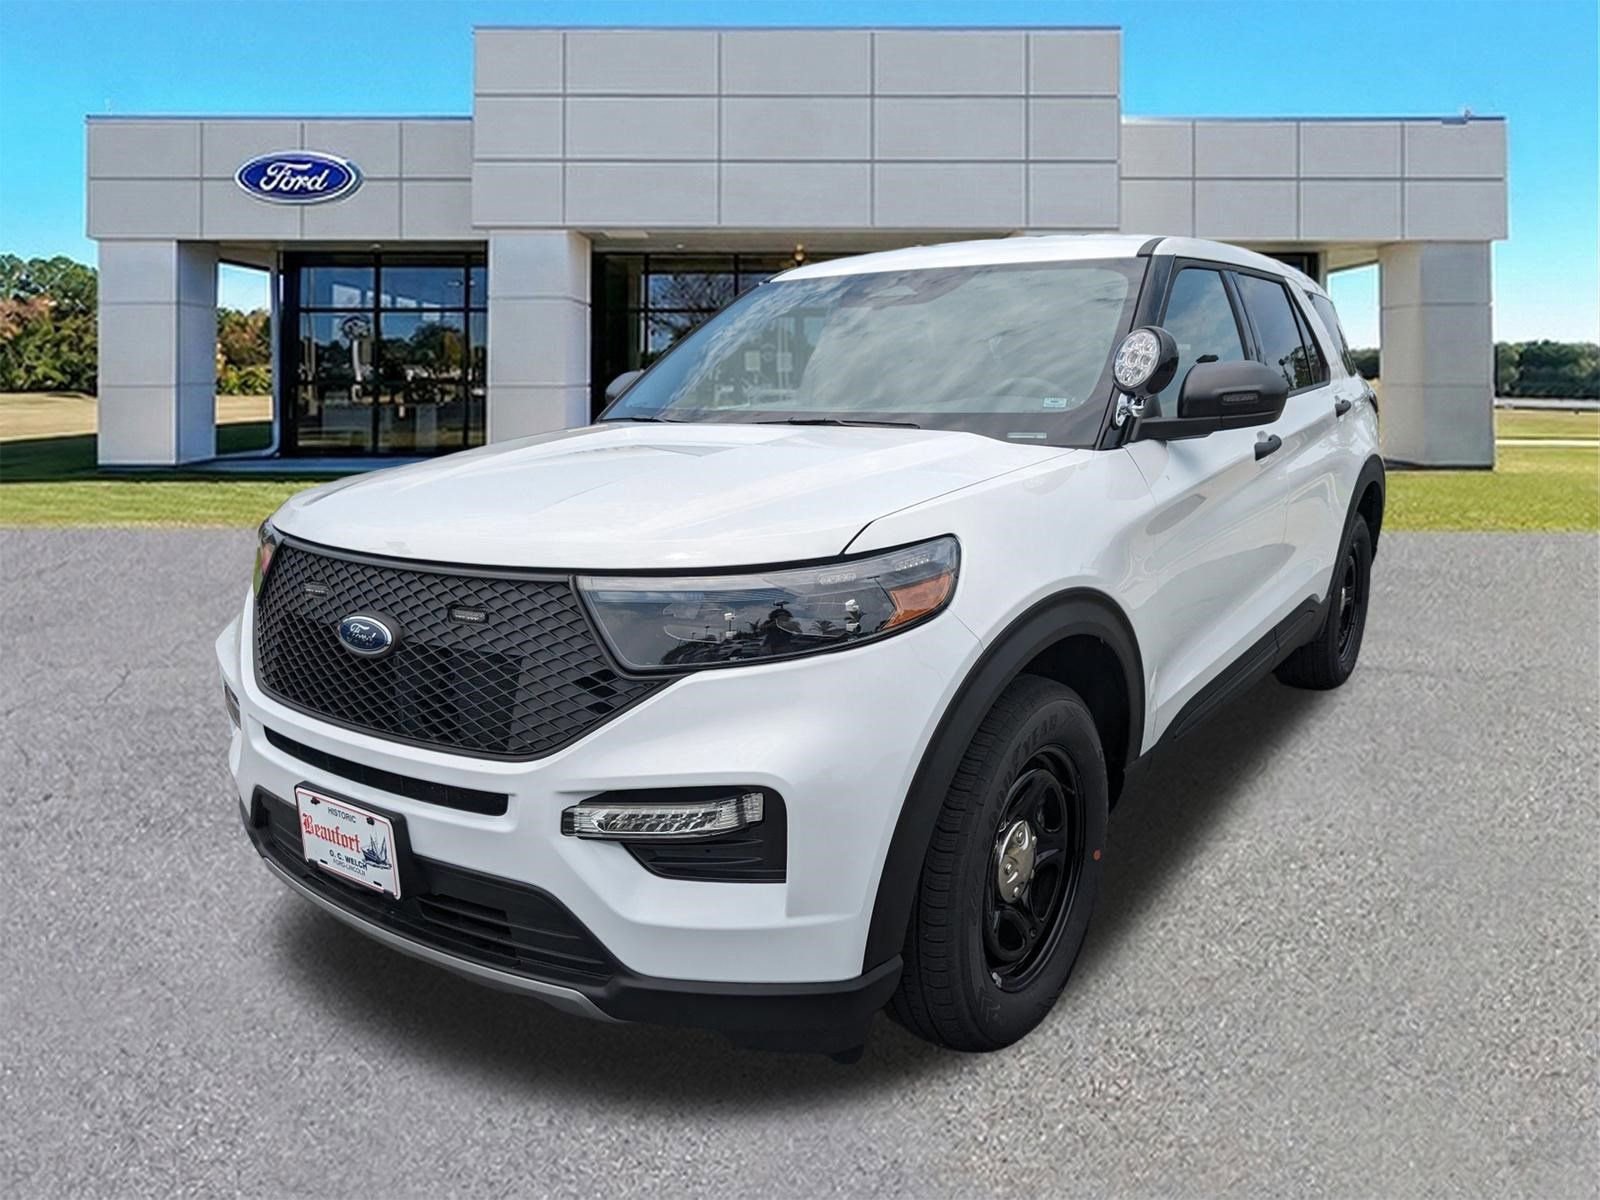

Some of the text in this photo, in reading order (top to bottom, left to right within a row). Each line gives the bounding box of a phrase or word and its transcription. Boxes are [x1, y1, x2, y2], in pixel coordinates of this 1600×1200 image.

[260, 162, 330, 191] Ford
[328, 807, 356, 823] HISTORIC
[303, 813, 360, 853] Beaufort
[344, 855, 367, 871] WELCH
